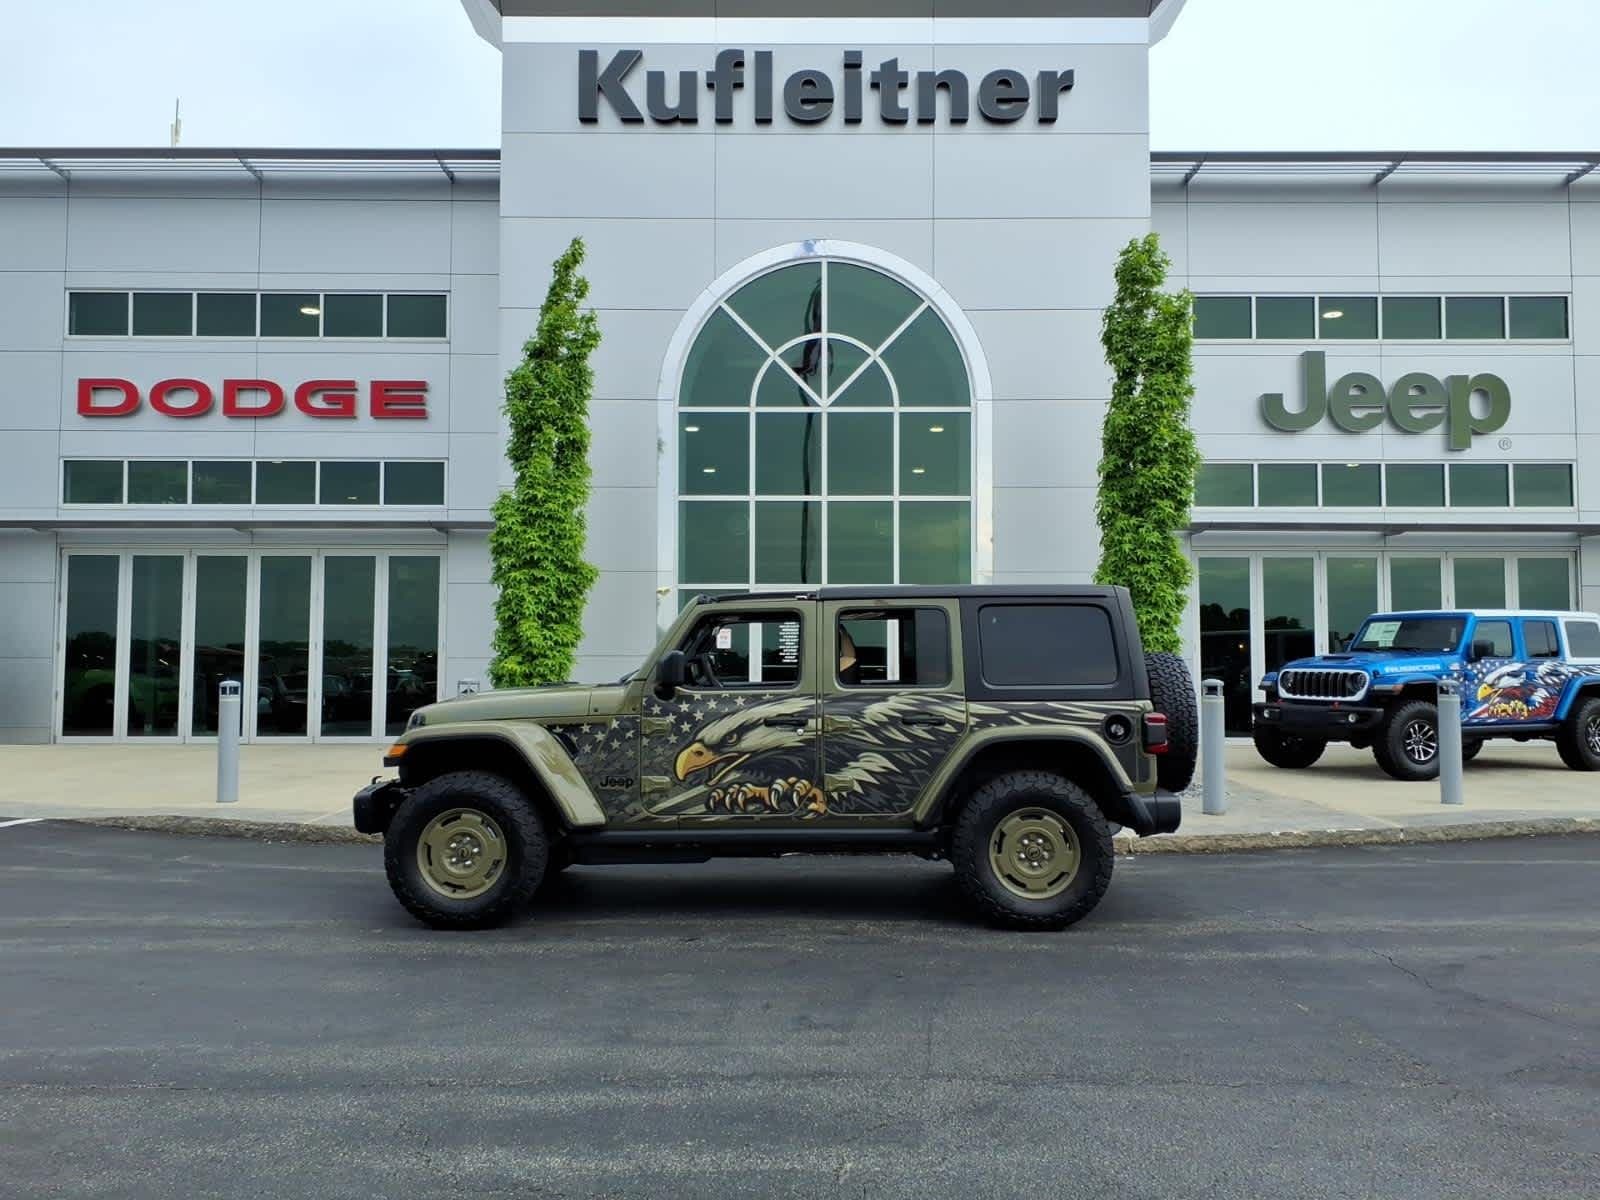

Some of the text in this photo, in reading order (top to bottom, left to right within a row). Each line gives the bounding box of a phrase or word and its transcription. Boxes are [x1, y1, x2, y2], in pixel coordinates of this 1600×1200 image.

[578, 48, 1075, 124] Kufleitner
[77, 378, 429, 419] DODGE
[1258, 350, 1511, 451] Jeep
[599, 775, 634, 789] Jeep
